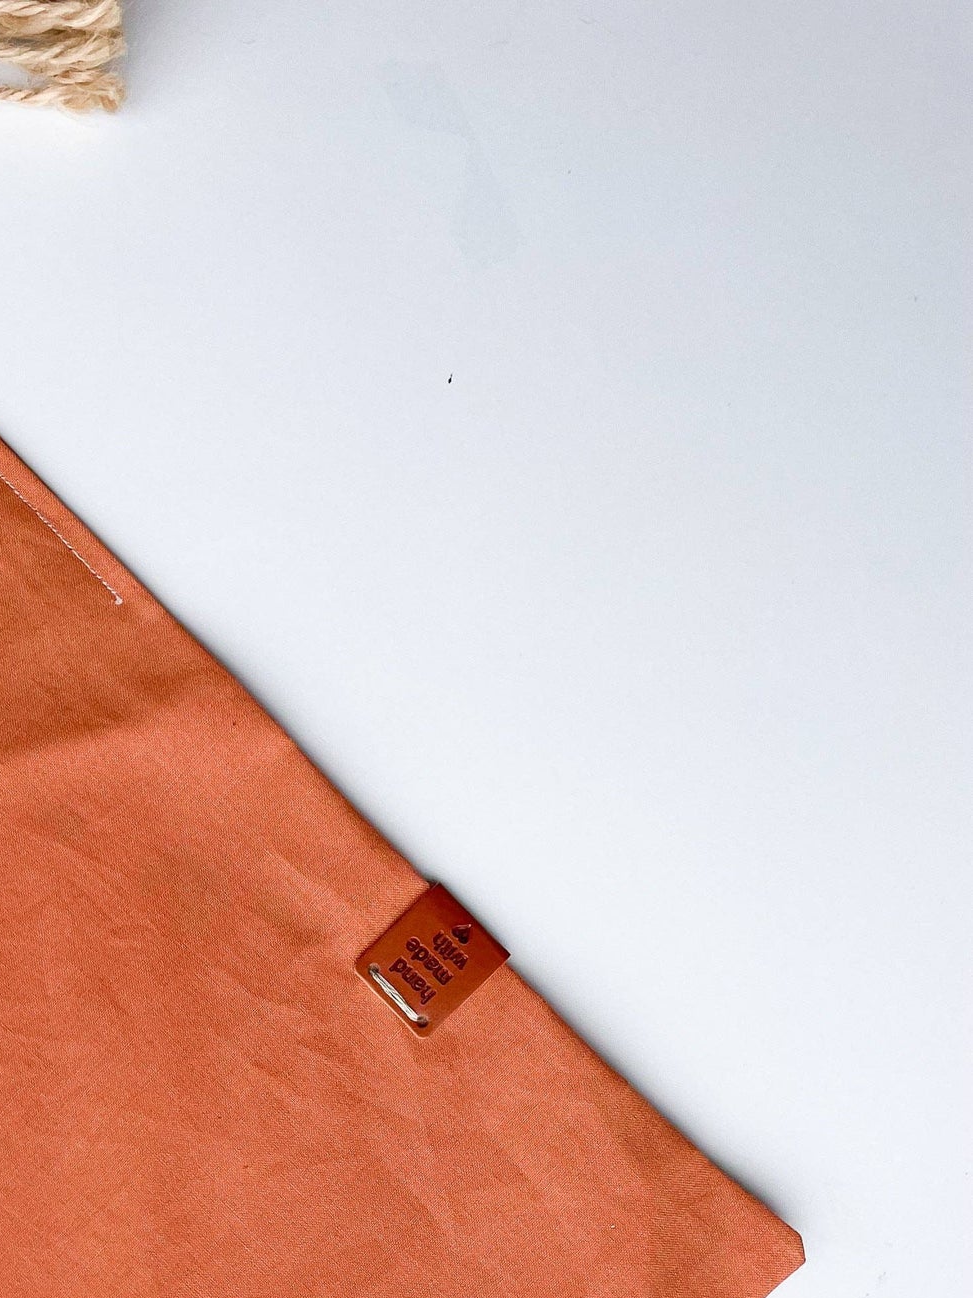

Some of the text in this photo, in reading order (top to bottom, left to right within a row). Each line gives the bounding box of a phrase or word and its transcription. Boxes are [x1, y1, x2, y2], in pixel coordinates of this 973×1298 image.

[406, 937, 454, 985] made
[433, 931, 468, 970] with
[389, 957, 436, 1004] hand
